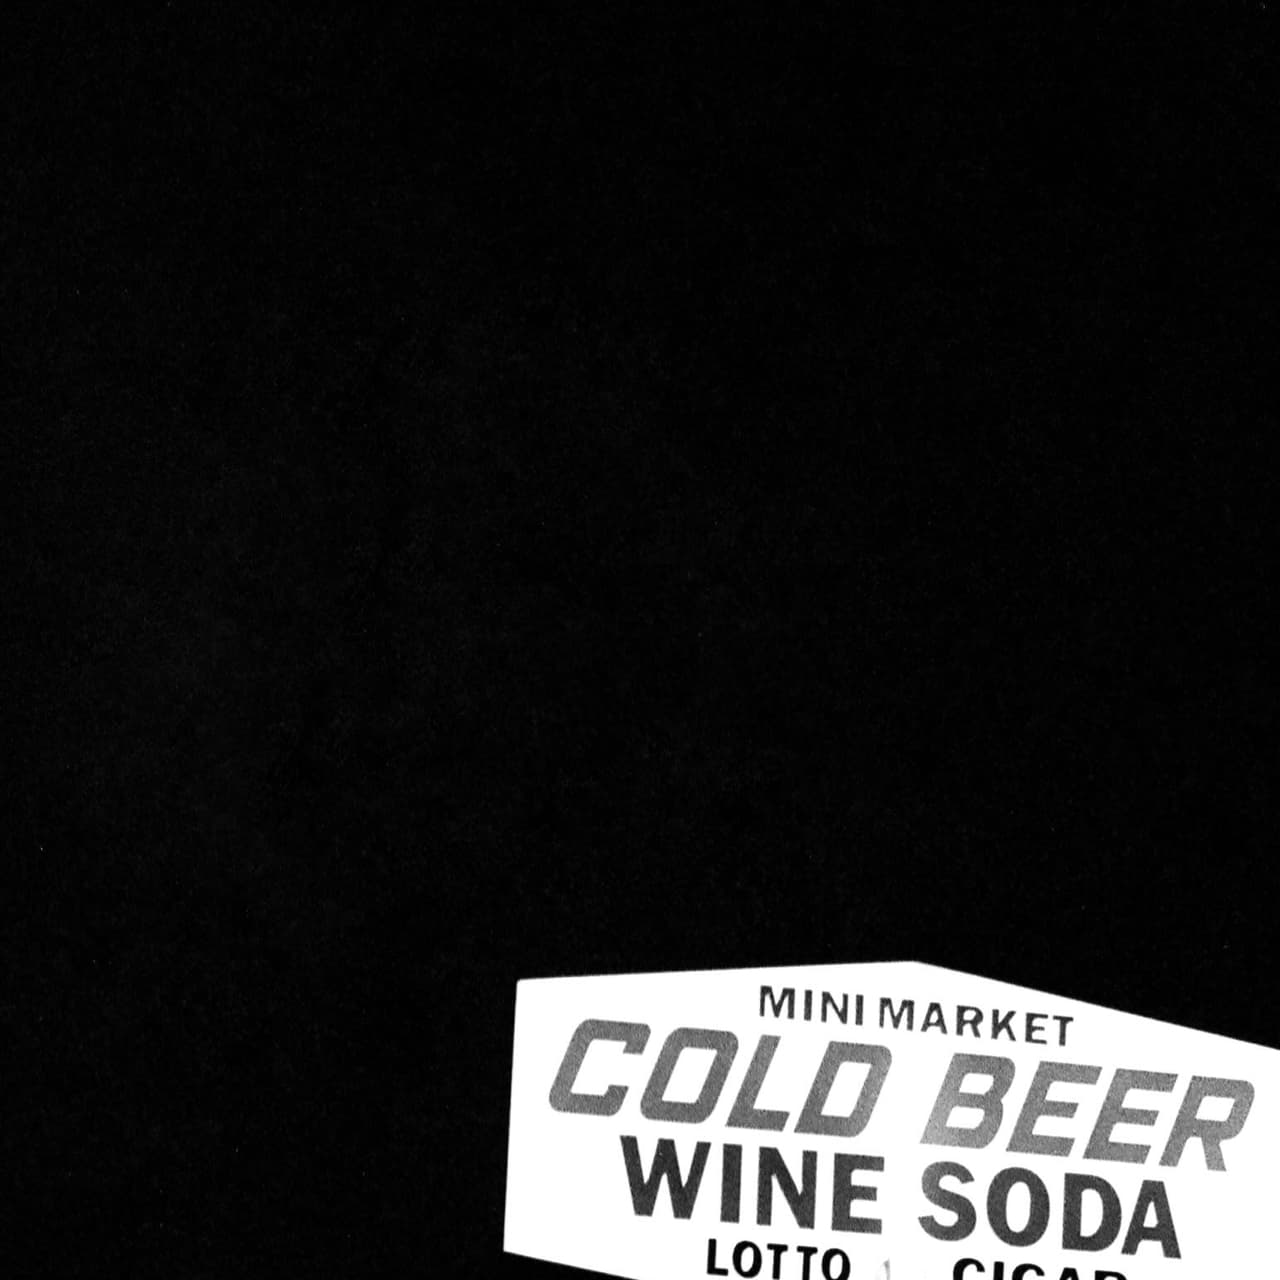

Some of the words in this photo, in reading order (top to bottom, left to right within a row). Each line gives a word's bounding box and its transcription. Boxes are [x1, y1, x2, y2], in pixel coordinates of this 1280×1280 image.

[758, 984, 865, 1027] MINI
[878, 997, 1075, 1048] MARKET
[548, 1017, 893, 1139] COLD
[919, 1051, 1257, 1173] BEER
[620, 1134, 886, 1236] WINE
[917, 1159, 1183, 1261] SODA
